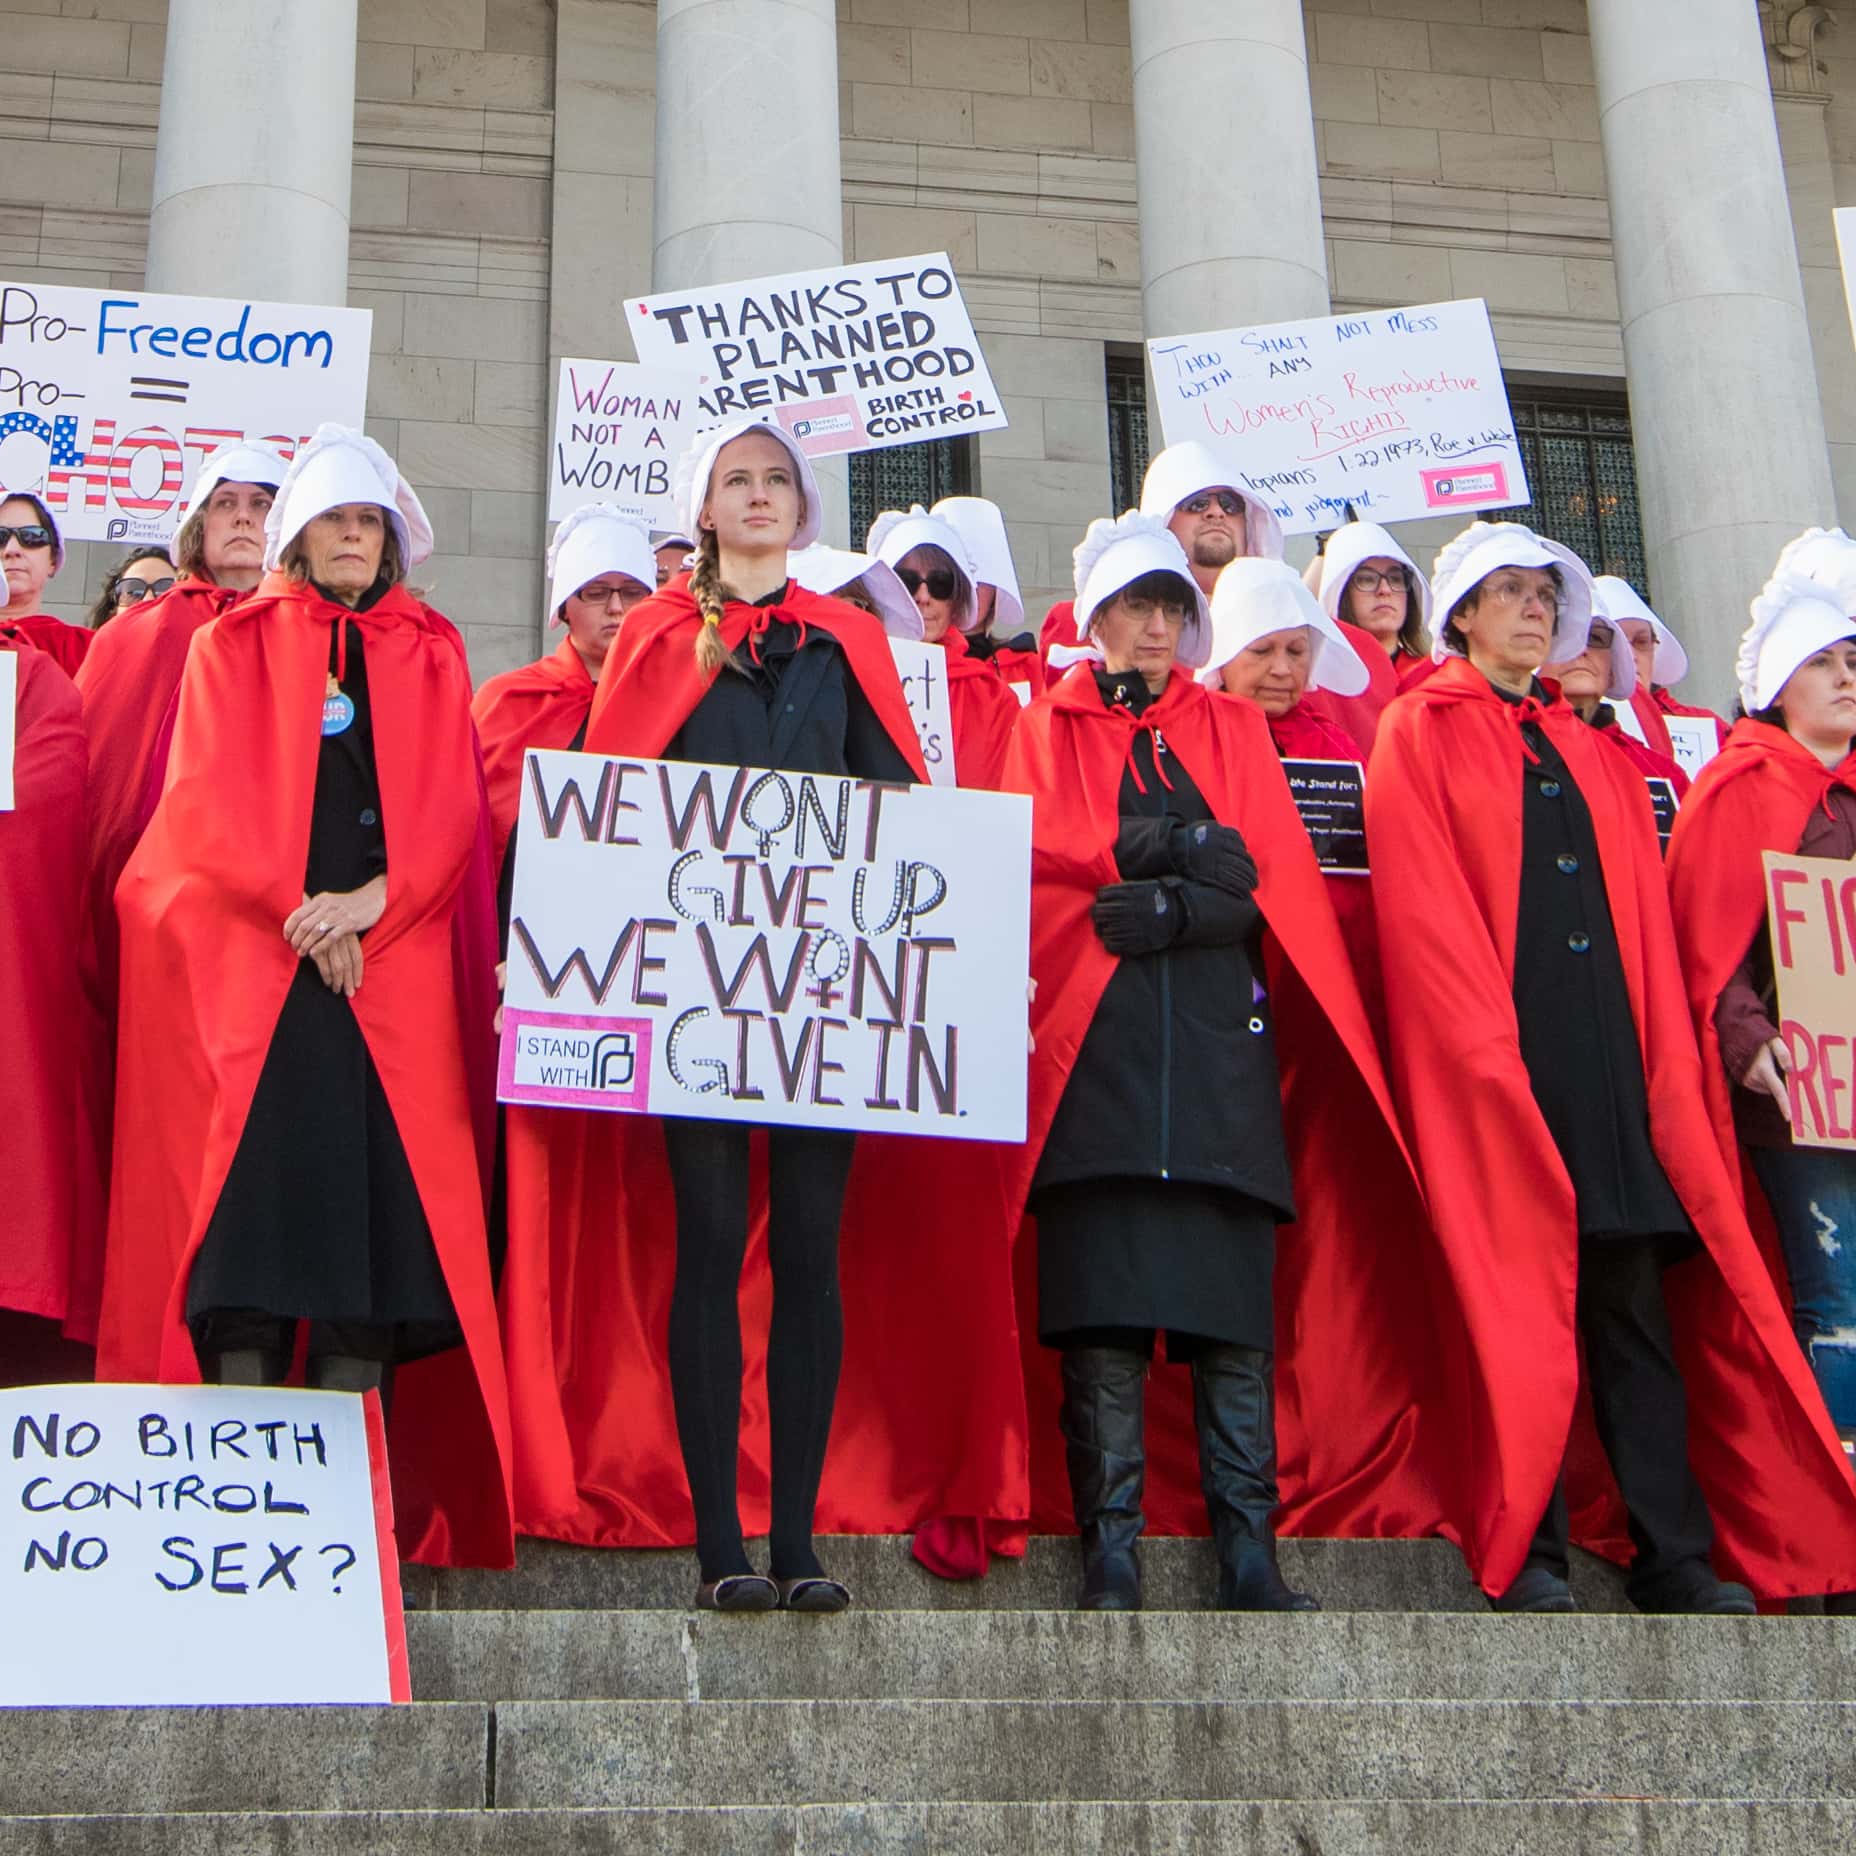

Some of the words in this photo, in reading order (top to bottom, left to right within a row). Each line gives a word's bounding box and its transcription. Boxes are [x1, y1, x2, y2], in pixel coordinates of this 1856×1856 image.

[653, 279, 868, 345] THANKS
[874, 267, 953, 307] TO
[712, 310, 936, 381] PLANNED
[1336, 321, 1371, 343] NOT
[698, 347, 975, 418] ARENTHOOD
[1269, 355, 1313, 379] ANY
[1343, 369, 1481, 407] Reproductive
[866, 399, 996, 439] CONTROL
[867, 387, 945, 417] BIRTH
[571, 423, 623, 445] NOT
[644, 427, 666, 450] A
[1430, 431, 1464, 454] Roe
[528, 753, 648, 846] WE
[667, 850, 835, 929] GIVE
[512, 916, 678, 1007] WE
[527, 1036, 591, 1059] STAND
[666, 1006, 850, 1106] GIVE
[540, 1066, 589, 1089] WITH
[12, 1413, 101, 1460] NO
[137, 1412, 328, 1467] BIRTH
[20, 1473, 310, 1516] CONTROL
[23, 1530, 108, 1572] NO
